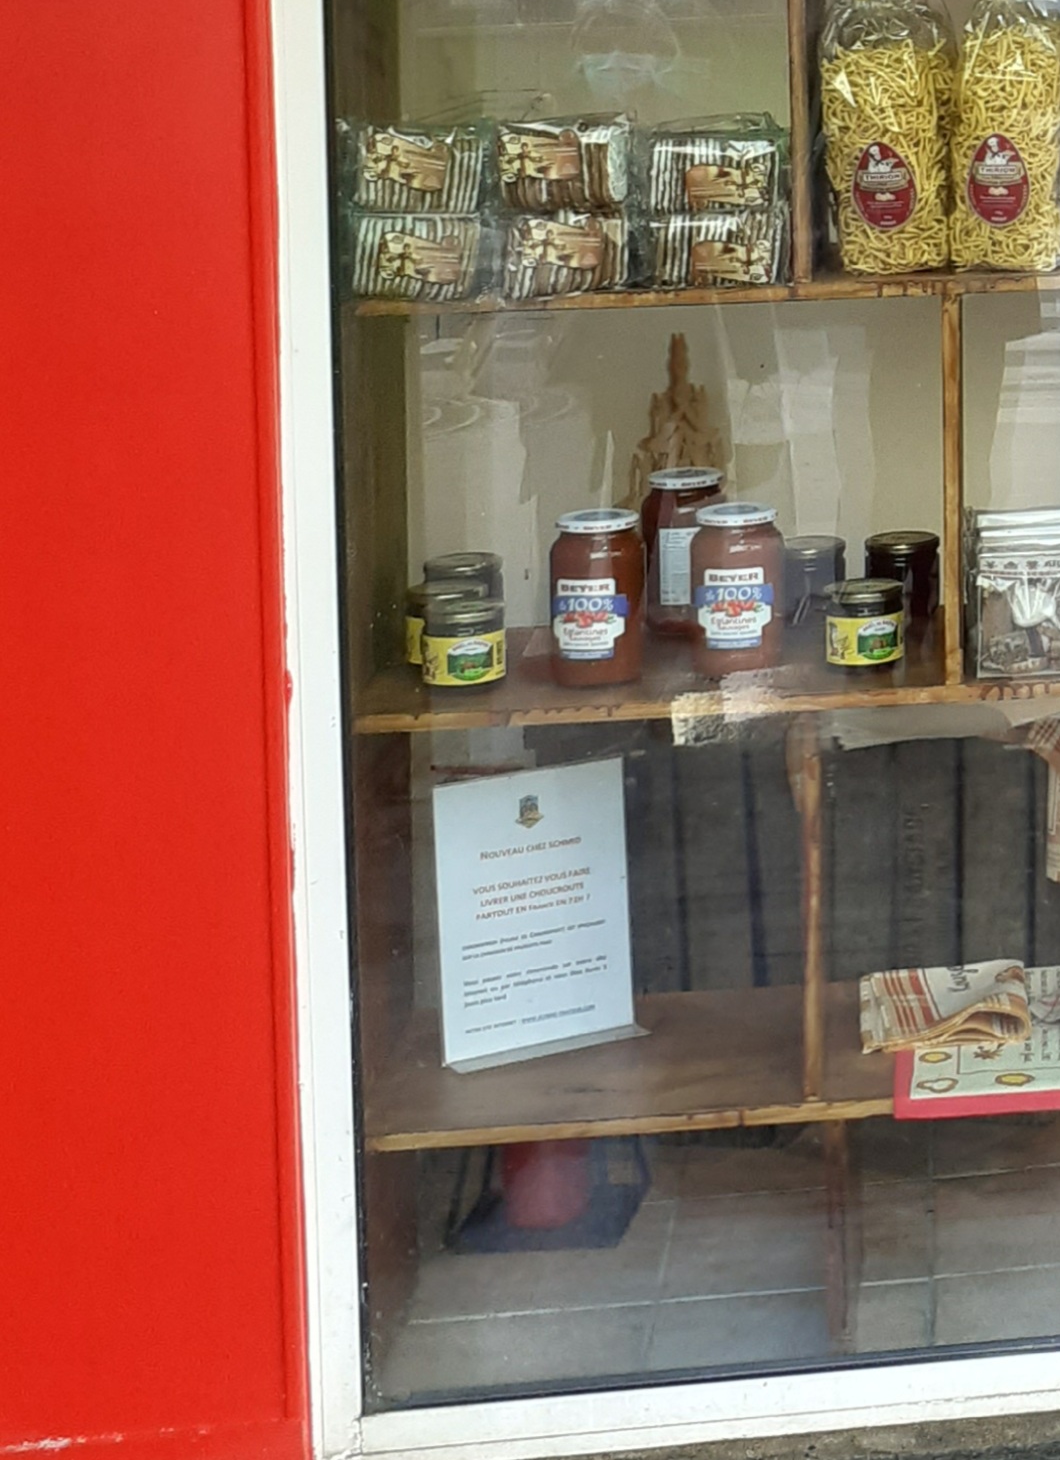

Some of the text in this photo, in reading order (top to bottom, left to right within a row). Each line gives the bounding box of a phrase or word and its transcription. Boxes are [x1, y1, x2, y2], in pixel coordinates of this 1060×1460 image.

[709, 572, 758, 582] BEYER
[717, 586, 762, 600] 100%
[567, 597, 614, 612] 100%
[472, 885, 496, 895] VOUS
[497, 877, 543, 891] SOUHAITEZ
[544, 871, 567, 883] VOUS
[480, 881, 584, 908] LIVRER UNE CHOUCROUTE
[475, 908, 513, 920] PARTOUT
[515, 905, 527, 914] EN
